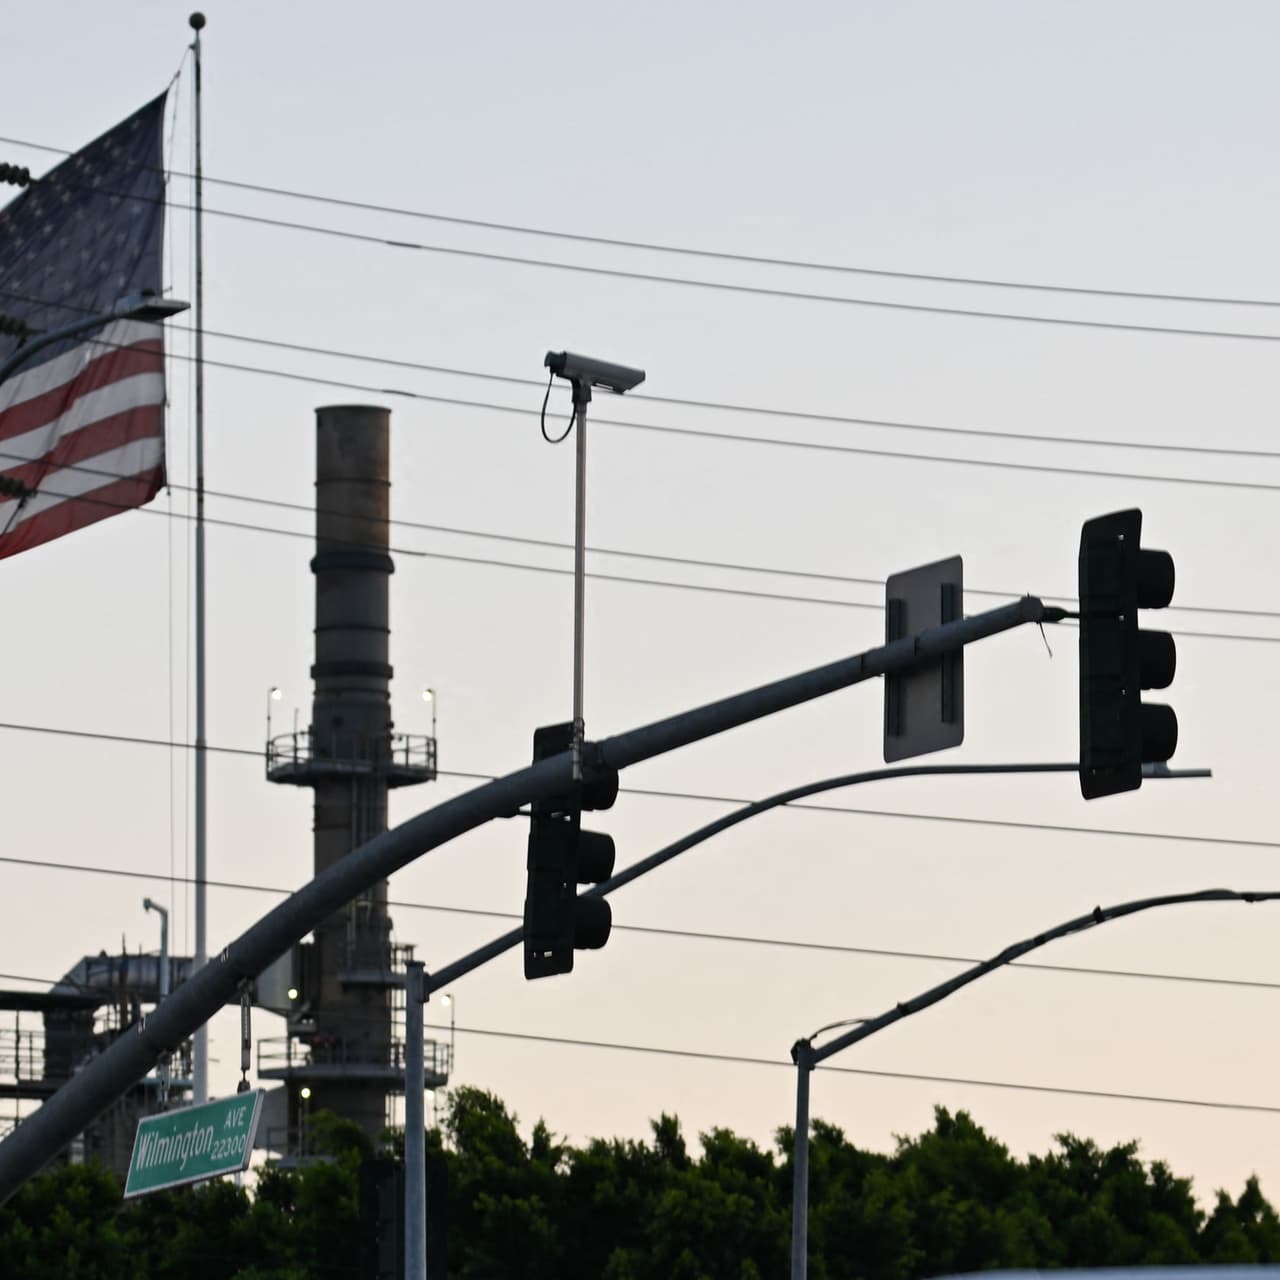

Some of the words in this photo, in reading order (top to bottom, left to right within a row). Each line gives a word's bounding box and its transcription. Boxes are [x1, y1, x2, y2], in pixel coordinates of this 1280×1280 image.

[136, 1121, 214, 1171] Wilmington
[224, 1106, 247, 1129] AVE
[210, 1134, 247, 1160] 22300
